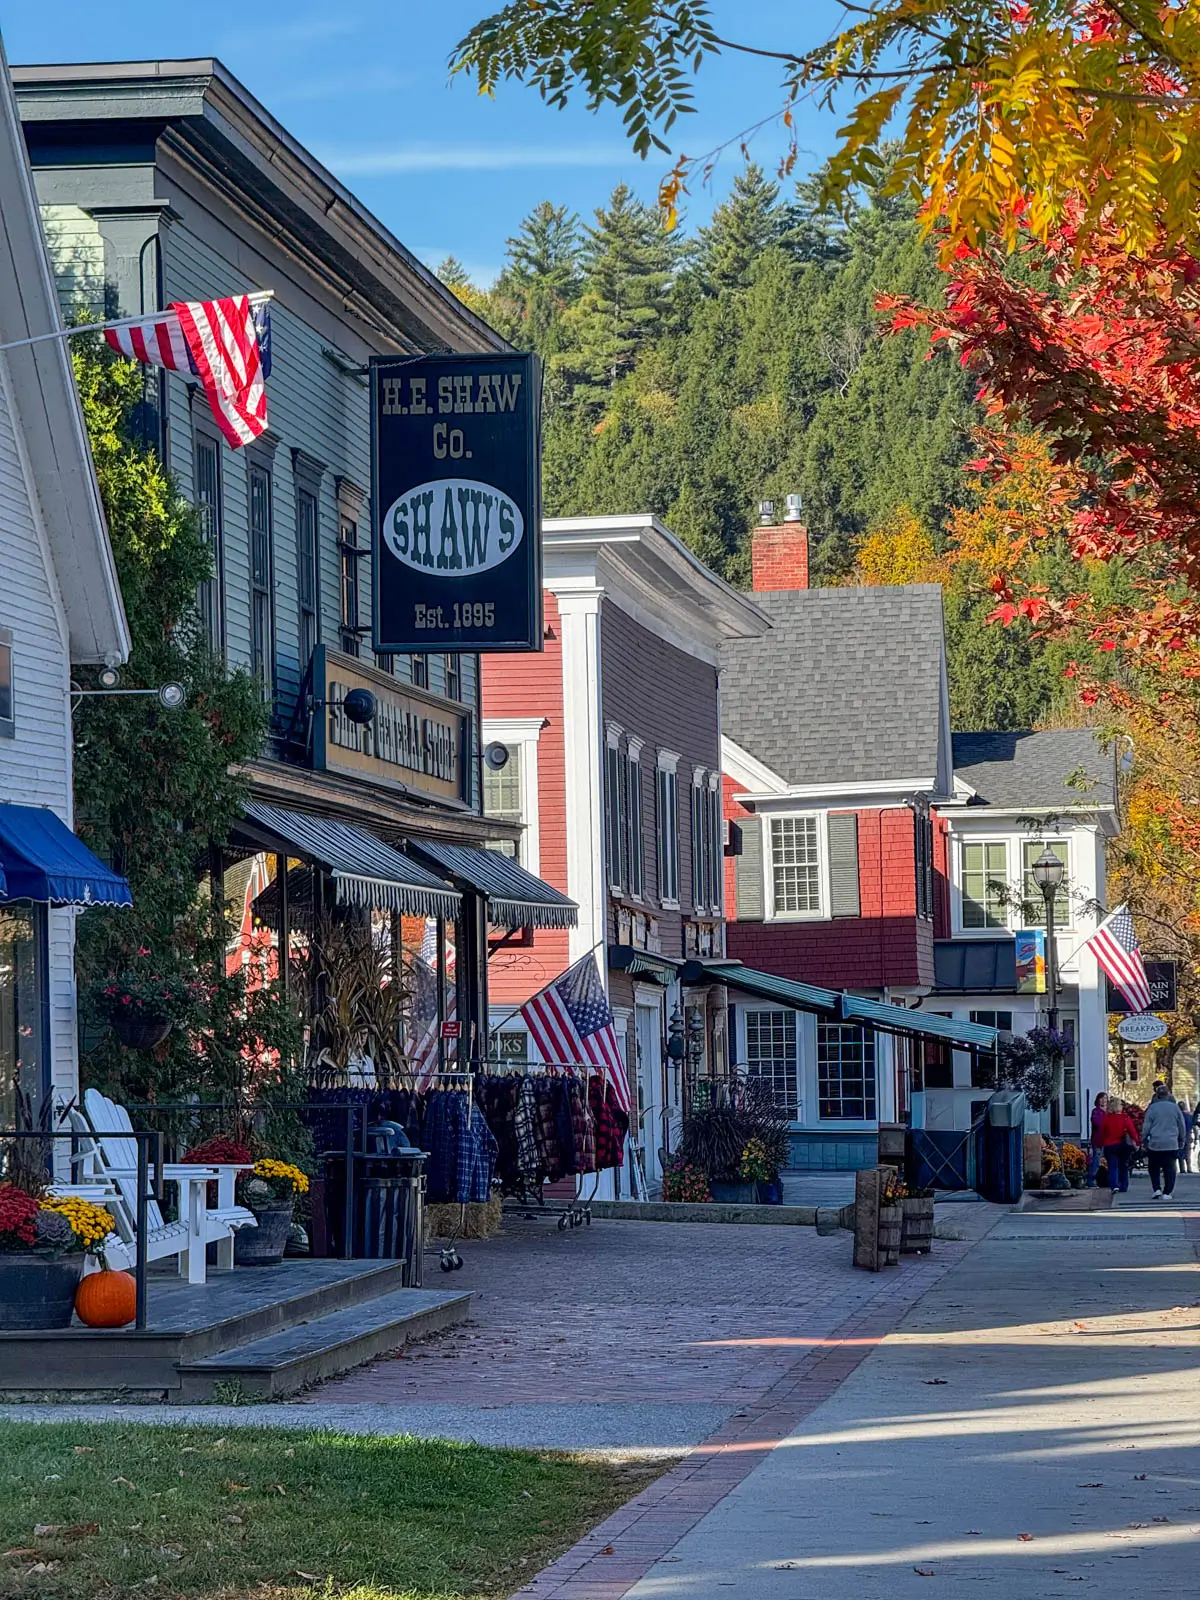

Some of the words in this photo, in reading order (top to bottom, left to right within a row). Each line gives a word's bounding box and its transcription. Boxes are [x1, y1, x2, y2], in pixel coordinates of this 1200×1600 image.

[382, 377, 433, 415] H.E.
[437, 374, 521, 413] SHAW
[433, 422, 472, 459] Co.
[392, 486, 515, 569] SHAW'S
[414, 603, 449, 629] Est.
[453, 602, 495, 628] 1895
[330, 681, 374, 756] SHS
[376, 699, 424, 773] GENERAL
[425, 718, 456, 782] STORE
[1150, 990, 1169, 999] NN
[1120, 1024, 1164, 1033] BREAKFAST
[488, 1039, 522, 1052] OOKS
